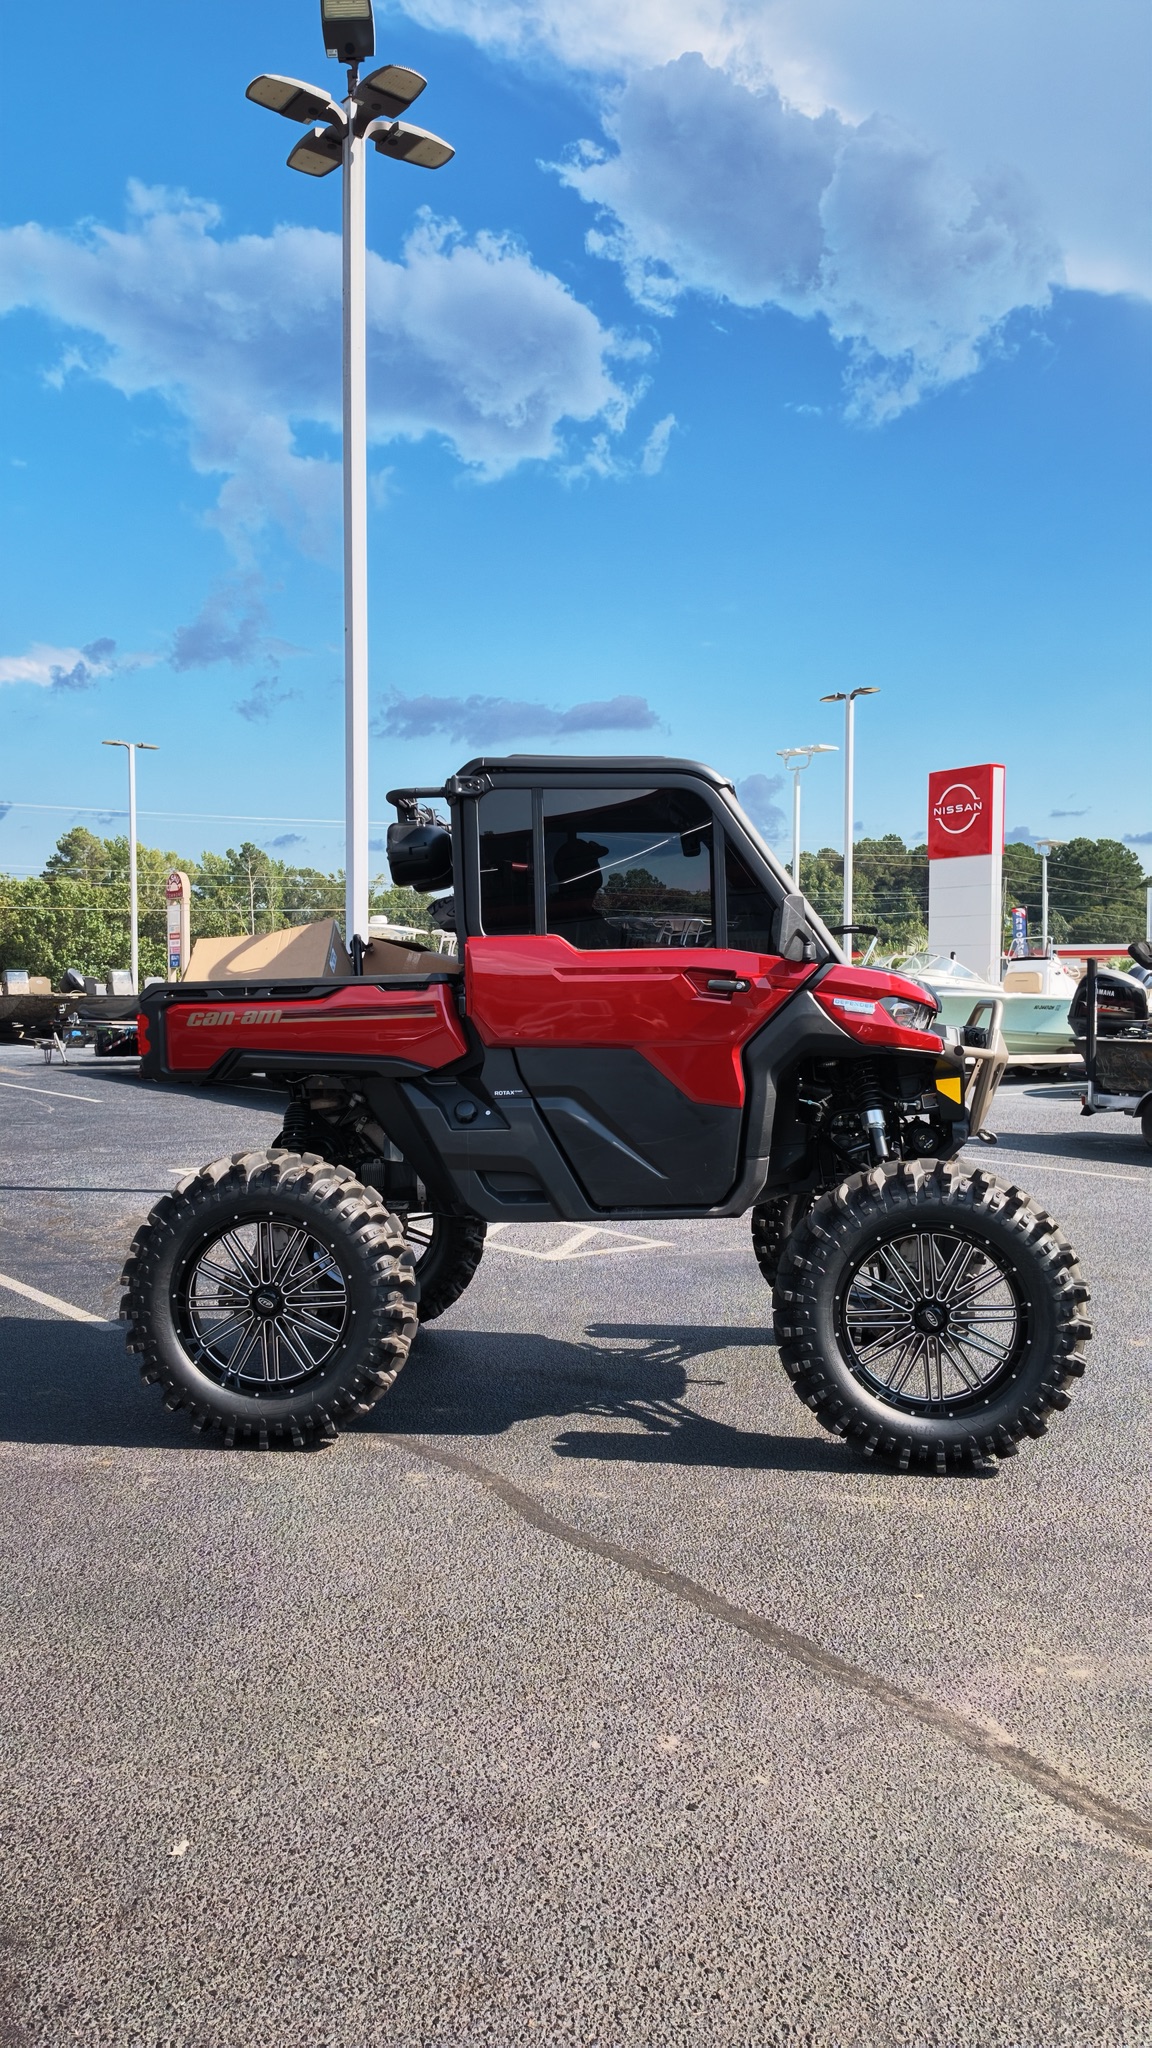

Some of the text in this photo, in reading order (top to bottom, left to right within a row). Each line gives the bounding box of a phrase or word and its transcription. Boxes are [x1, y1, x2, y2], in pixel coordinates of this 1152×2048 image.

[933, 801, 982, 816] NISSAN
[834, 998, 874, 1009] DEFENDER
[186, 1009, 283, 1027] can-am
